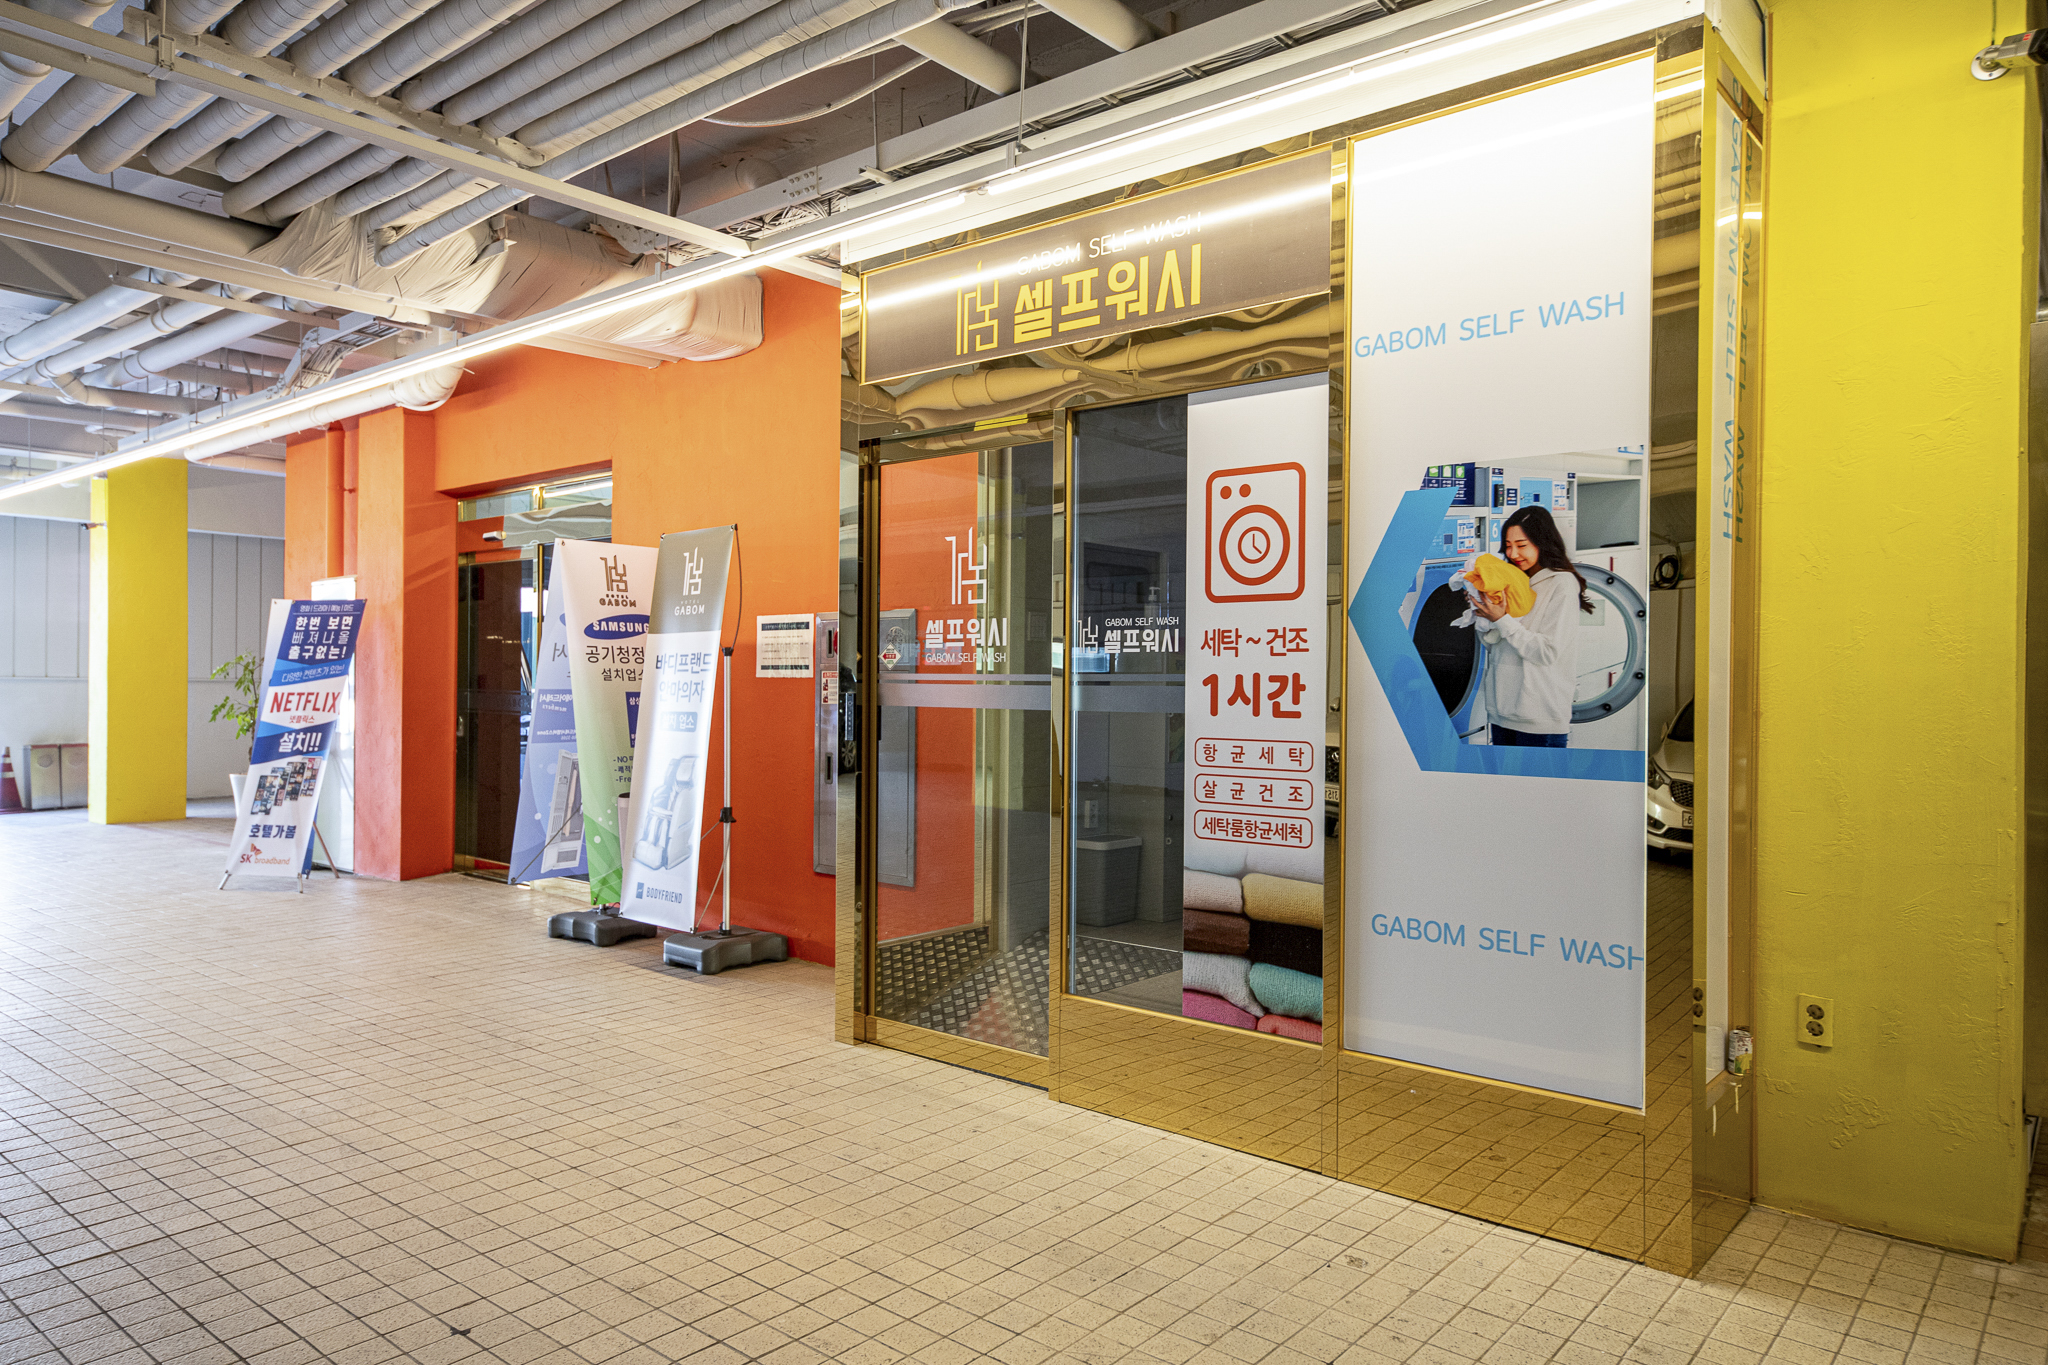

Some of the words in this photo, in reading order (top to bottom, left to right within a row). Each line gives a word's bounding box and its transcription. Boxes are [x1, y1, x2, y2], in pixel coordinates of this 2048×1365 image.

[1089, 228, 1134, 259] SELF
[1144, 211, 1202, 244] WASH
[1013, 243, 1202, 344] 셀프워시
[1354, 322, 1446, 358] GABOM
[1459, 309, 1525, 341] SELF
[1538, 291, 1625, 328] WASH
[599, 598, 637, 608] GABOM
[674, 604, 705, 616] GABOM
[327, 615, 353, 630] 보면
[1105, 618, 1133, 627] GABOM
[1135, 617, 1154, 626] SELF
[1156, 616, 1180, 626] WASH
[925, 617, 1007, 649] 셀프워시
[1104, 628, 1180, 654] 셀프워시
[655, 652, 713, 675] 바디프랜드
[925, 652, 956, 663] GABOM
[958, 652, 978, 663] SELF
[270, 691, 341, 714] NETFLIX
[1202, 672, 1307, 719] 1시간
[679, 714, 695, 730] 업소
[278, 731, 322, 753] 설치!!
[240, 853, 253, 864] SK
[254, 856, 291, 866] broadband
[646, 886, 683, 904] BODYFRIEND
[1371, 913, 1465, 947] GABOM
[1479, 927, 1546, 956] SELF
[1559, 937, 1645, 972] WASH
